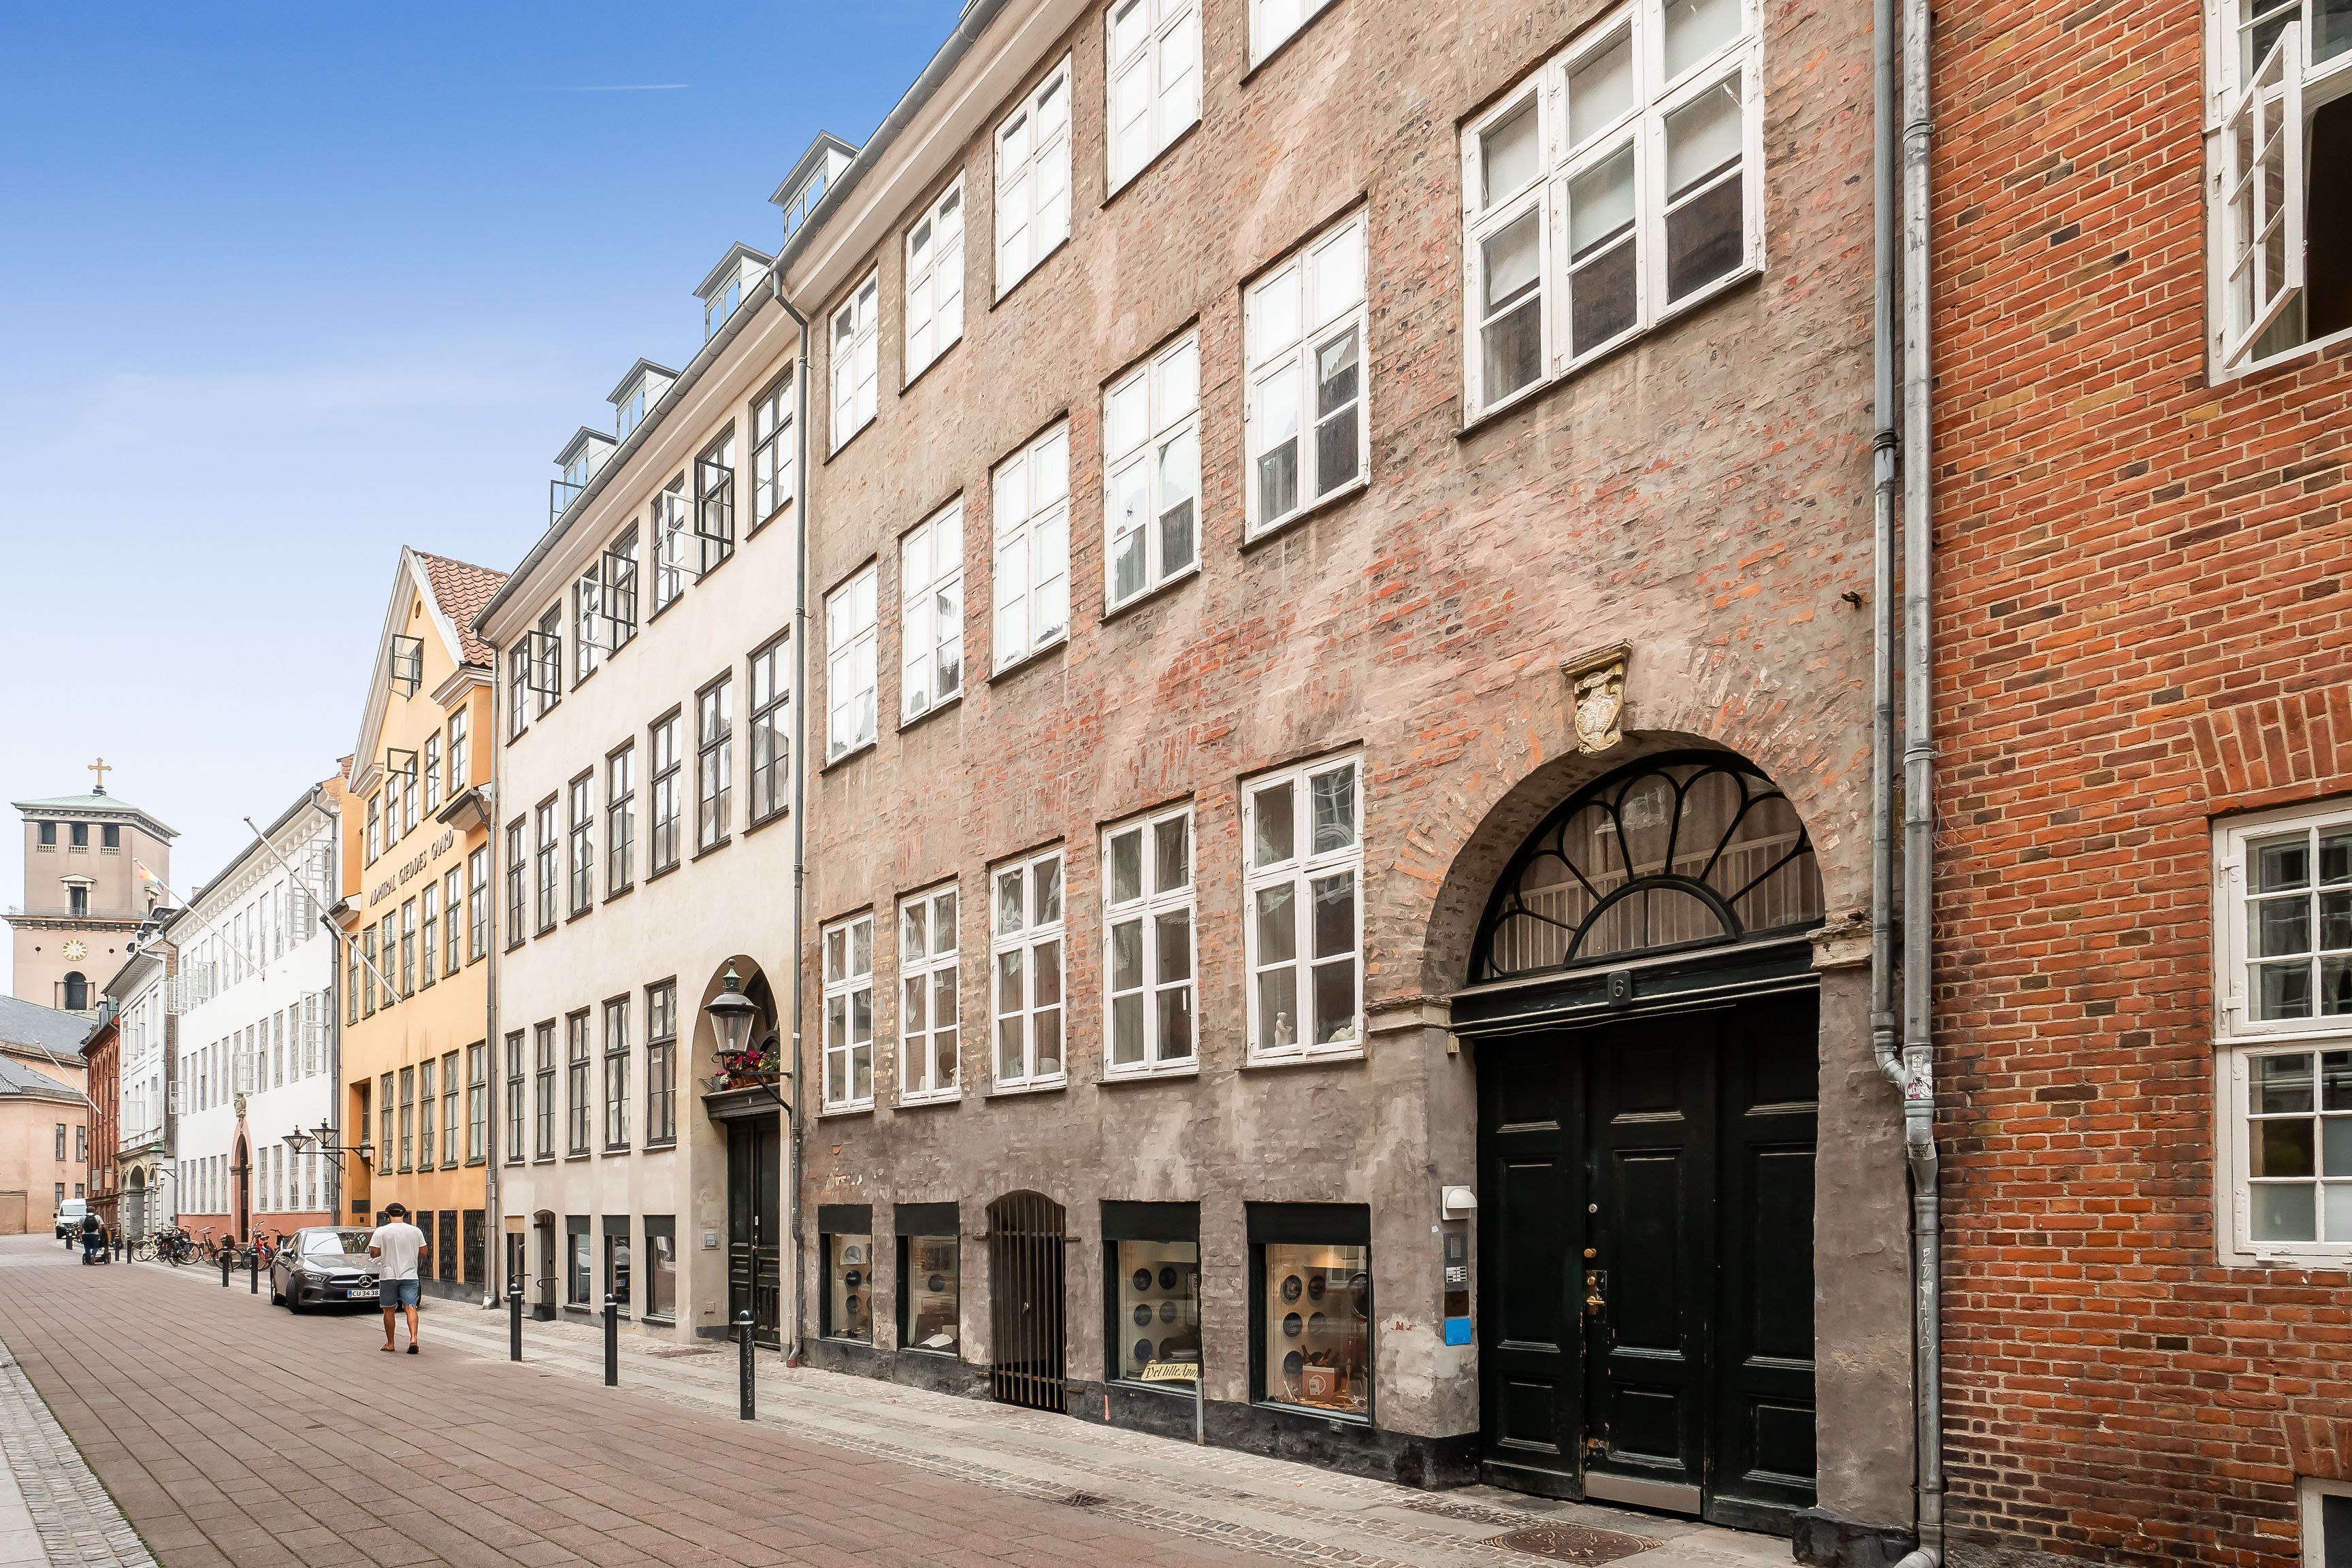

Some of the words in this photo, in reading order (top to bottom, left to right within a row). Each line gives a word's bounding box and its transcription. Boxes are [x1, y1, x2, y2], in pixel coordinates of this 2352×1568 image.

[370, 875, 396, 907] ADMIRAL
[431, 829, 454, 860] GAARD
[1614, 979, 1624, 997] 6
